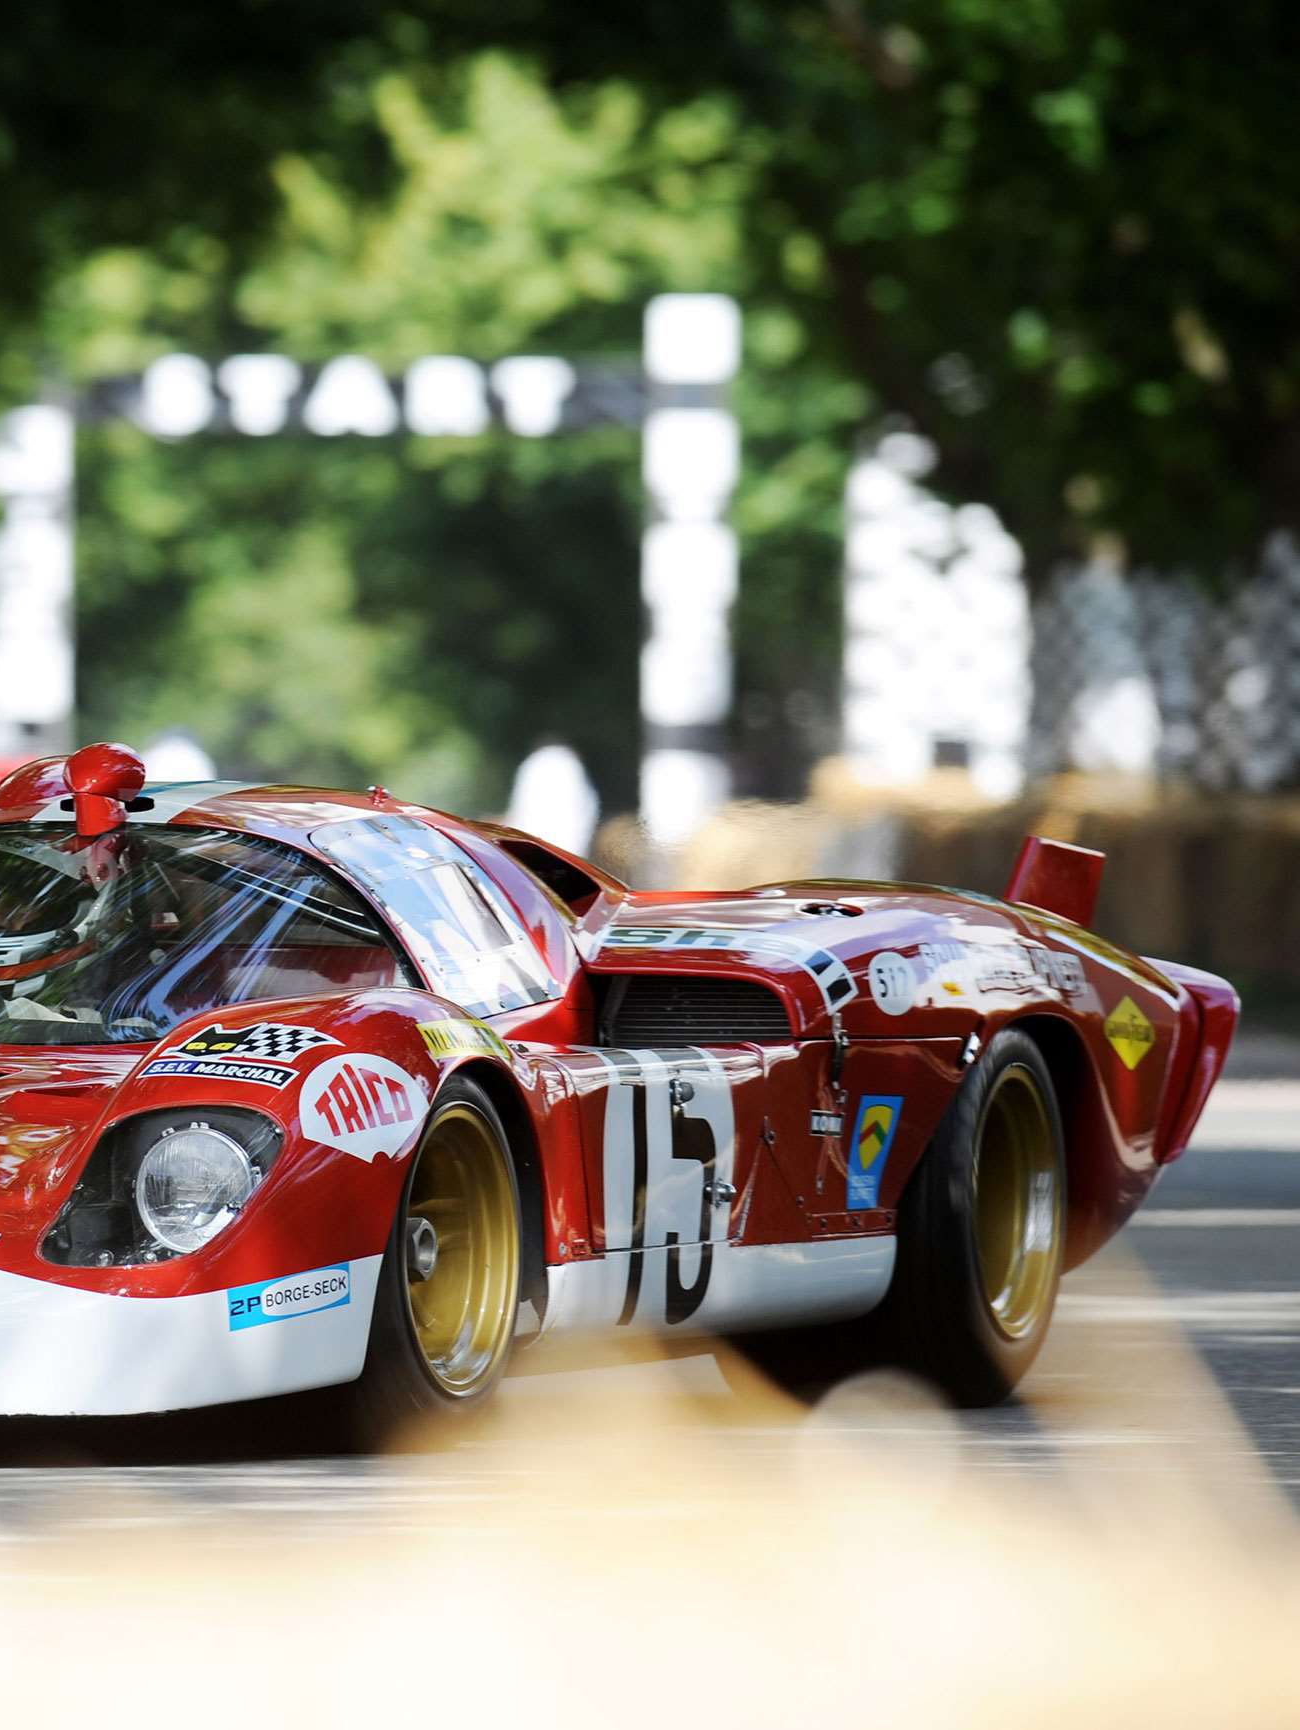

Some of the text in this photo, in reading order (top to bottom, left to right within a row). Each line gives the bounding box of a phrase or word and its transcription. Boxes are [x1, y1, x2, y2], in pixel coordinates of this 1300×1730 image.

[140, 353, 575, 438] START
[149, 1061, 286, 1084] S.E.V. MARCHAL
[314, 1063, 414, 1137] TRICO
[602, 1049, 717, 1326] 15
[265, 1275, 348, 1308] BORGE-SECK
